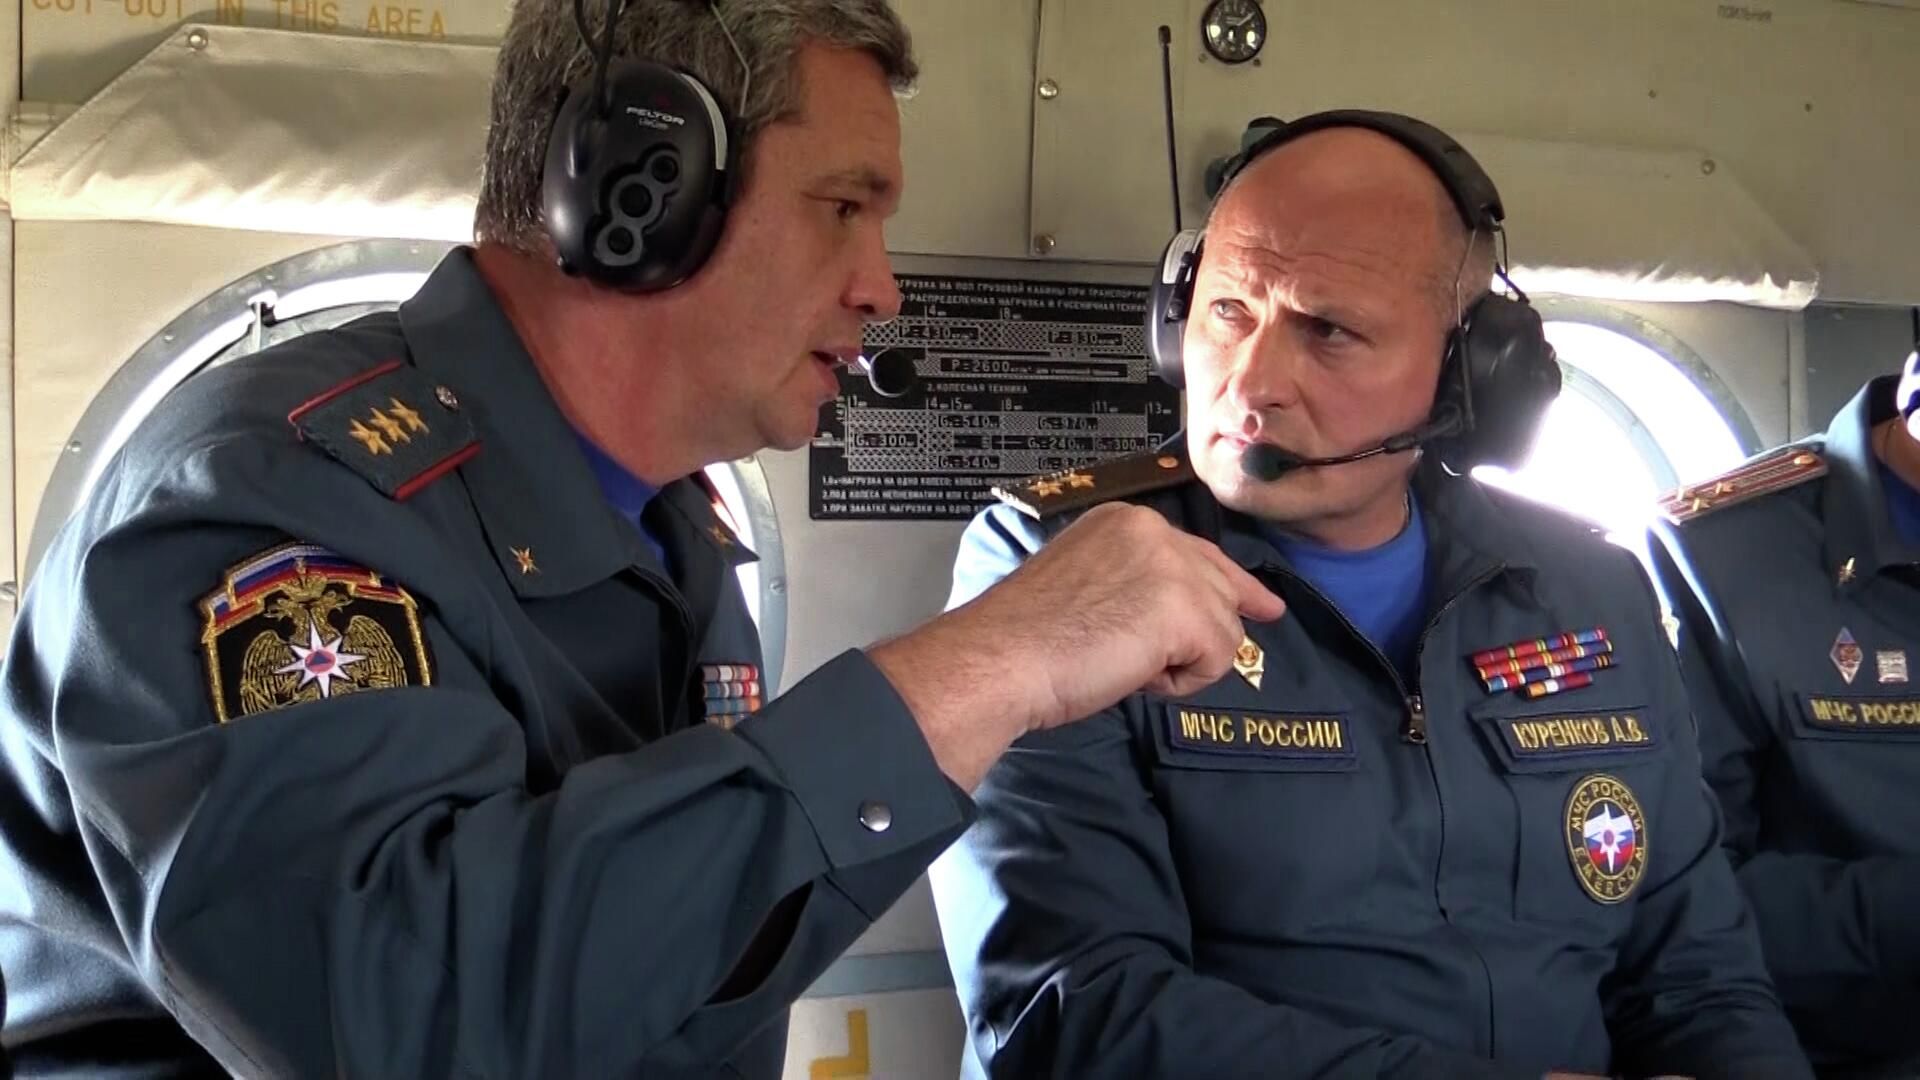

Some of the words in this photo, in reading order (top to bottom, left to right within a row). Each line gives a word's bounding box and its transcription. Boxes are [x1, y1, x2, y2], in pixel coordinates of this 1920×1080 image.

[215, 0, 244, 26] IN
[274, 0, 340, 31] THIS
[366, 6, 446, 38] AREA
[626, 106, 685, 126] PELTOR
[1810, 699, 1857, 722] МЧС
[1180, 711, 1235, 743] МЧС
[1243, 716, 1343, 748] РОССИИ
[1511, 716, 1610, 749] КУРЕНКОВ
[1571, 791, 1591, 833] МЧС
[1591, 782, 1643, 832] РОССИИ
